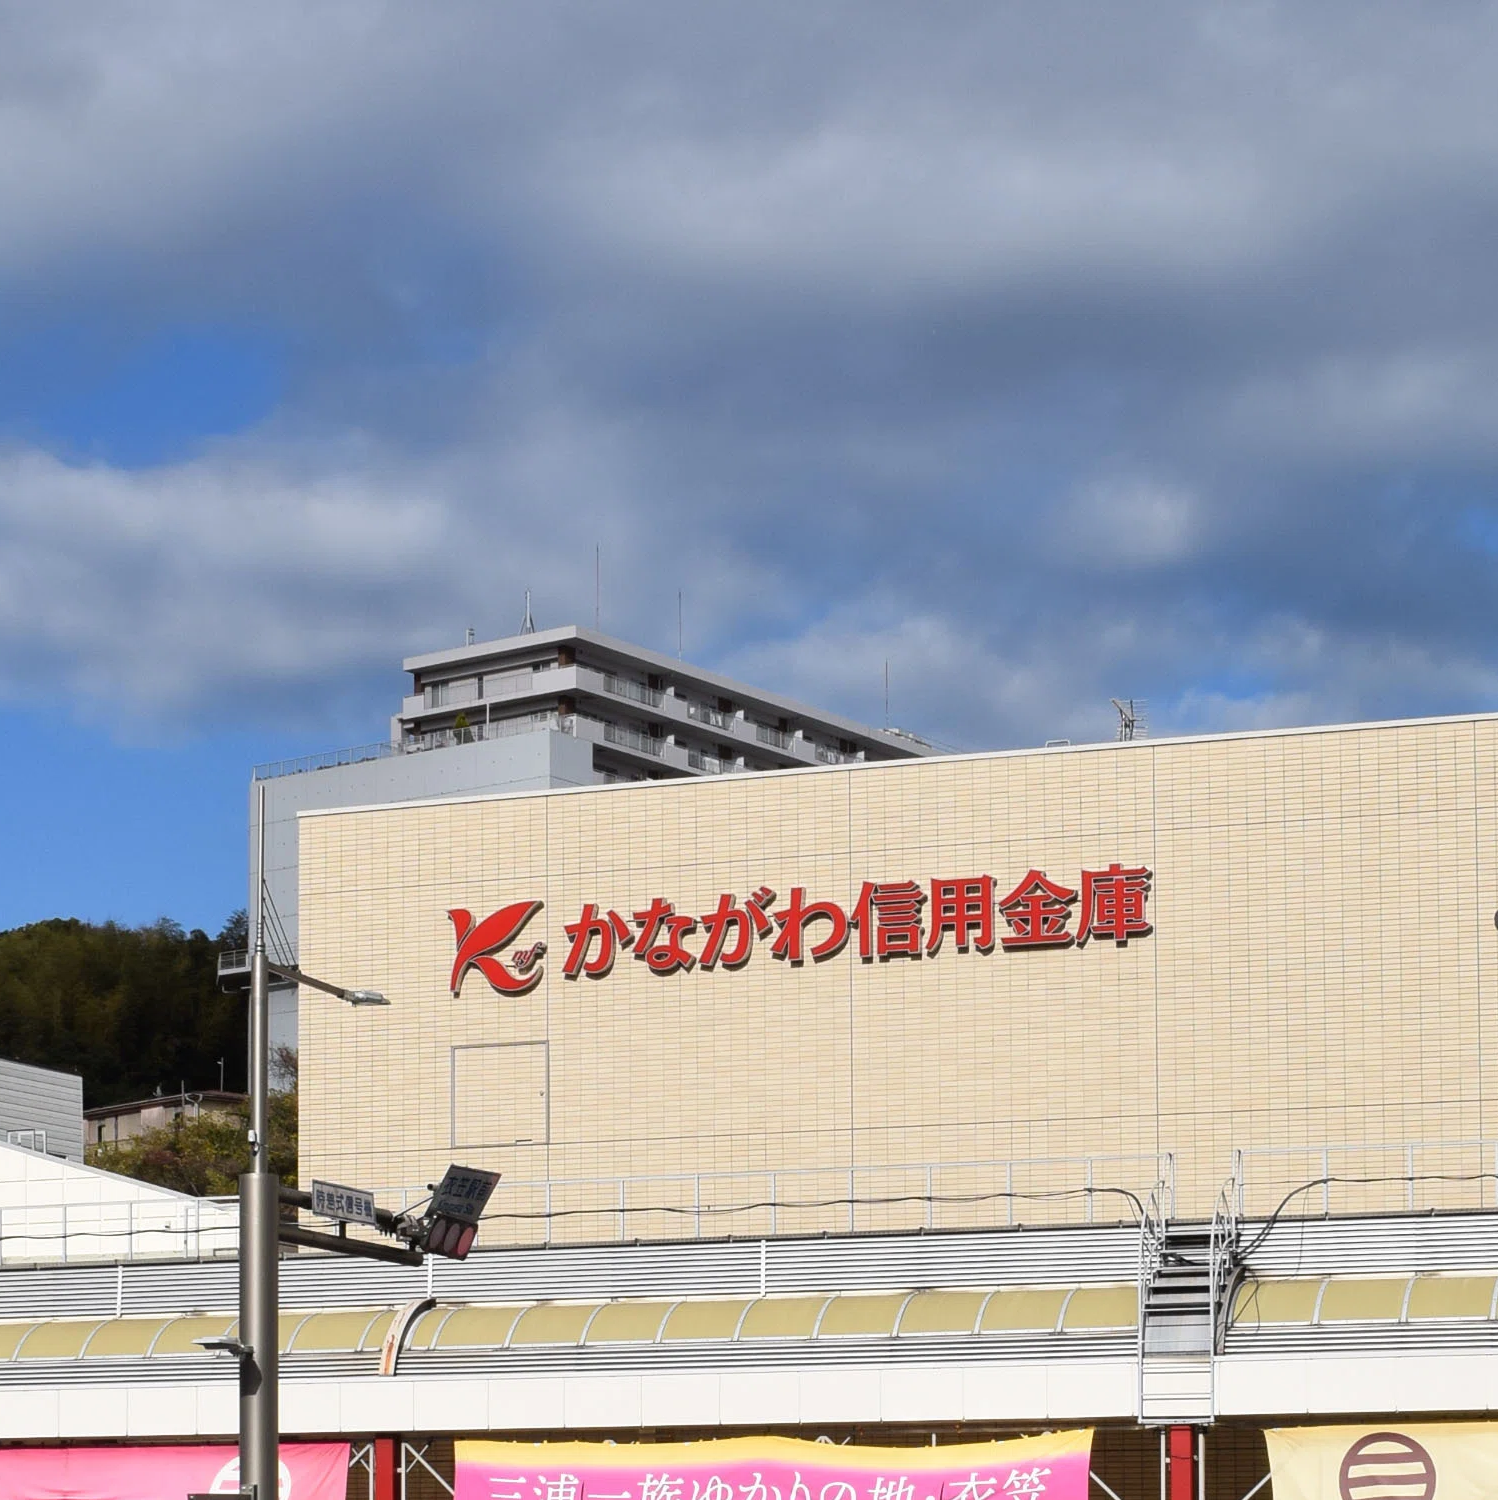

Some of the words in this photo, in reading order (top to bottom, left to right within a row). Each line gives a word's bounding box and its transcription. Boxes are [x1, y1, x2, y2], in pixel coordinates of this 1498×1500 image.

[561, 863, 1153, 980] かながわ信用金庫
